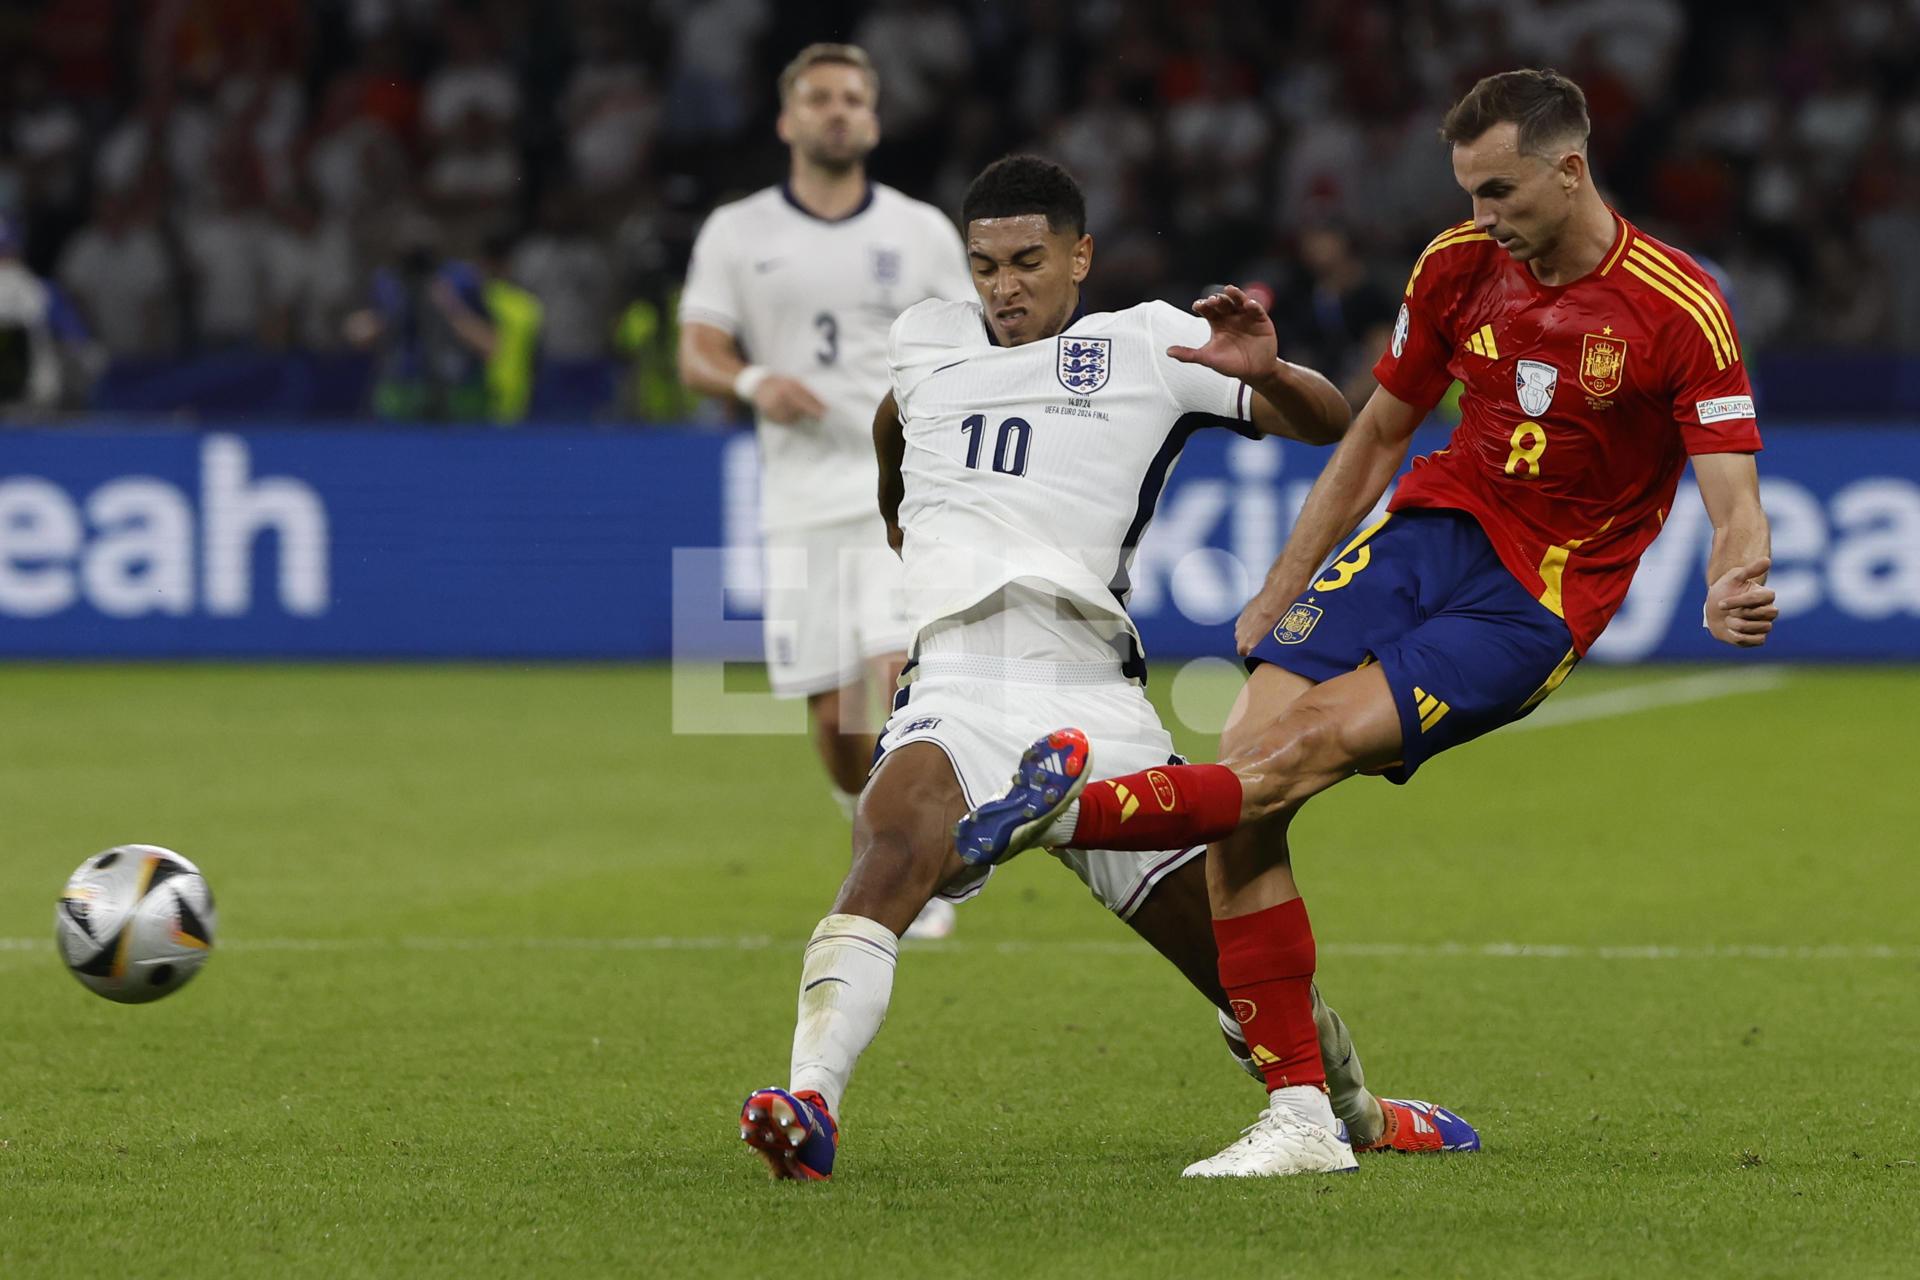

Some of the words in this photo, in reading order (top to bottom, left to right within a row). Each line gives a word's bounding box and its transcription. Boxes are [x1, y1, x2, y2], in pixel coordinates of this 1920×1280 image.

[813, 310, 838, 366] 3
[1045, 405, 1060, 414] UEFA
[1061, 406, 1077, 416] EURO
[1077, 409, 1092, 418] 2024
[1093, 411, 1109, 421] FINAL
[1700, 403, 1753, 416] FOUNDATION
[961, 414, 1033, 478] 10
[1504, 421, 1547, 476] 8
